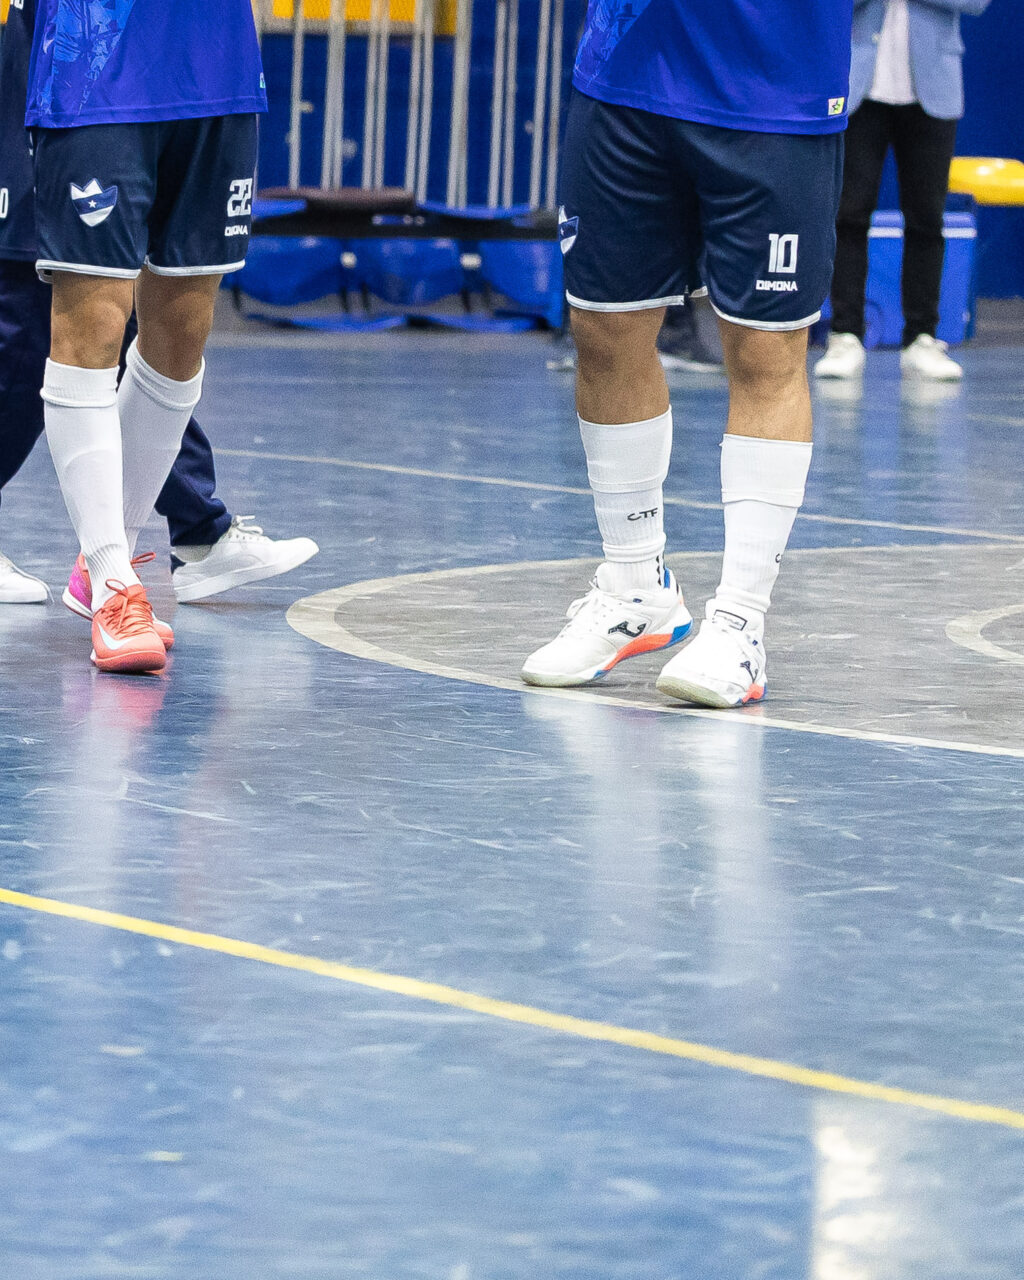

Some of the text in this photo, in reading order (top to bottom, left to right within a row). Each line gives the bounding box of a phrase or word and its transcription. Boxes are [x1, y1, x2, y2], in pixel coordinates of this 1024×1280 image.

[227, 178, 253, 217] 22
[768, 233, 799, 274] 10
[755, 279, 799, 291] DIMONA
